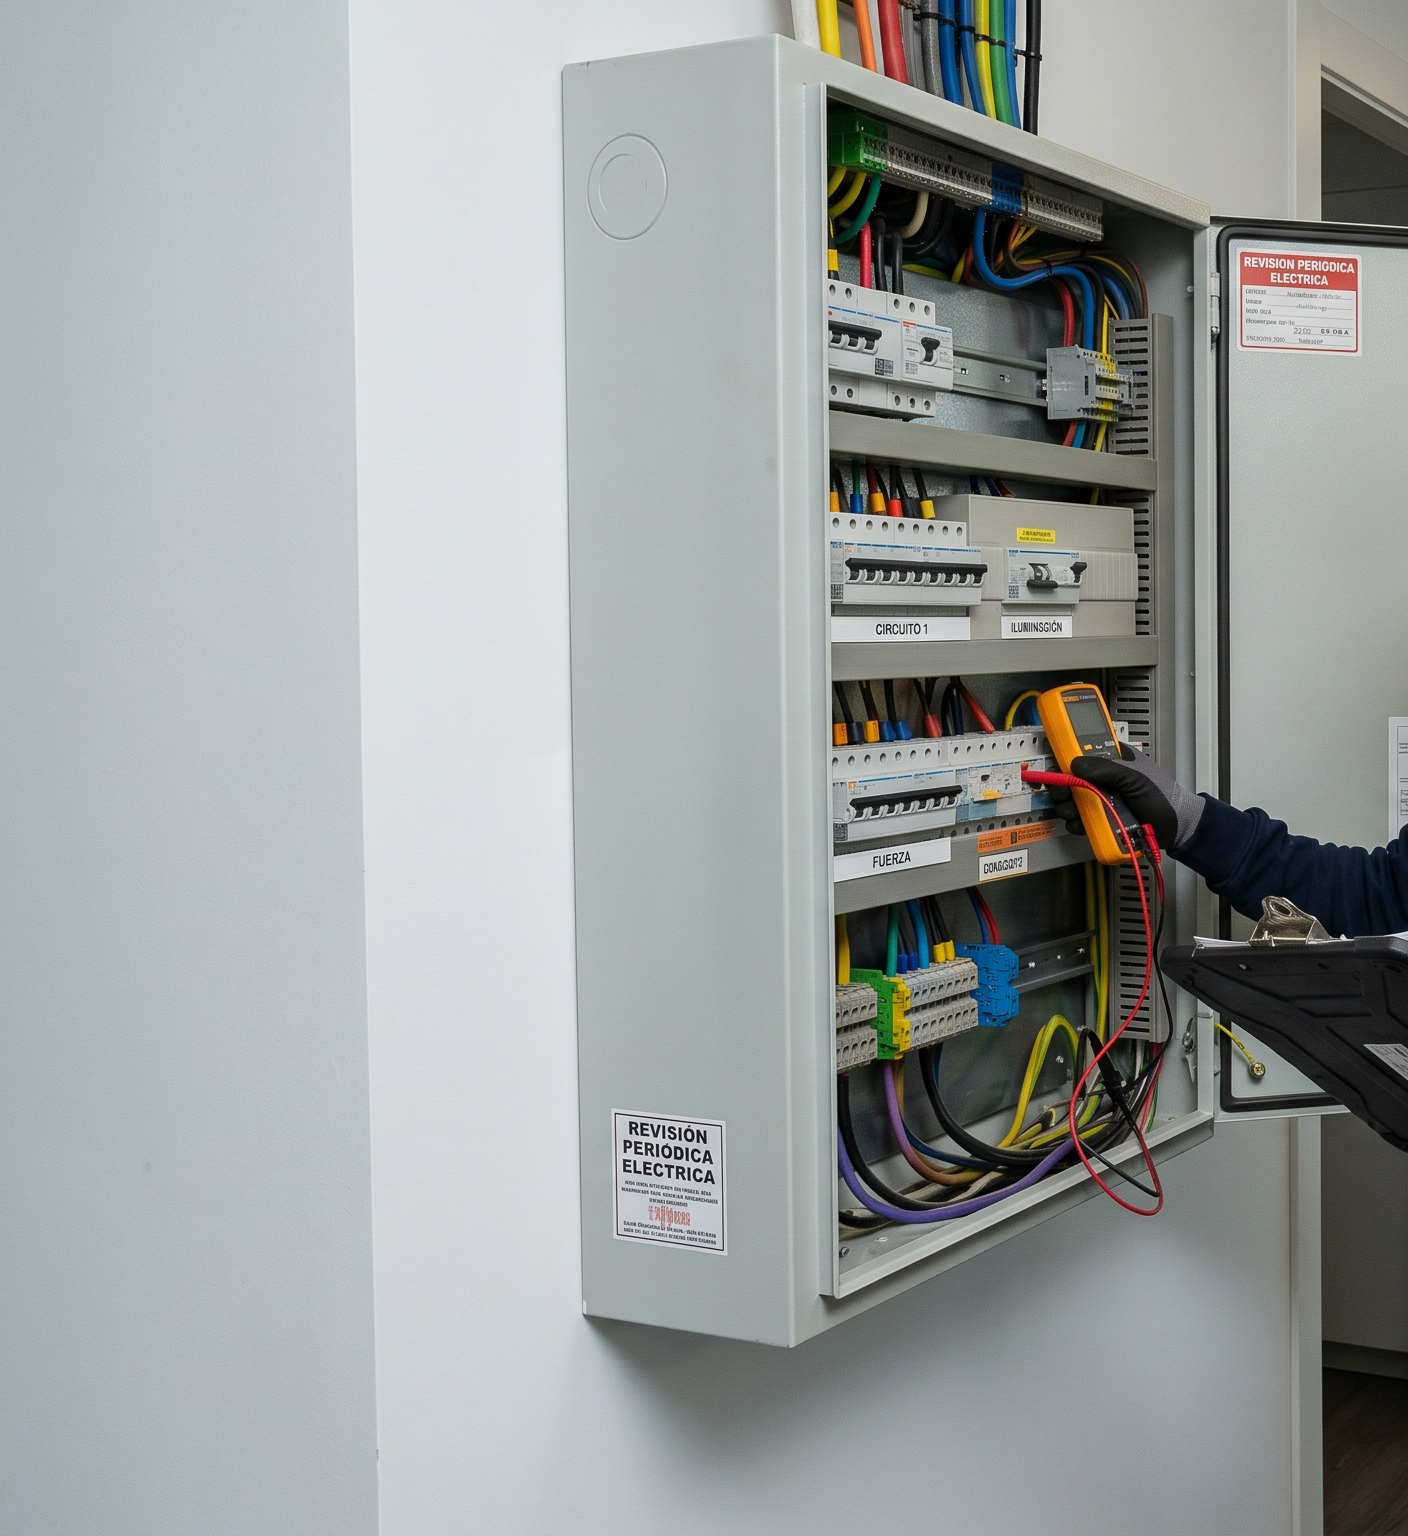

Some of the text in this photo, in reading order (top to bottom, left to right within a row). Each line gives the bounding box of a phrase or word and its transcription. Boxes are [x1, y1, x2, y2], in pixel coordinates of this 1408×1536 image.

[1244, 257, 1295, 270] REVISION
[1270, 272, 1329, 286] ELECTRICA
[875, 623, 928, 636] CIRCUITO 1
[872, 851, 911, 869] FUERZA
[628, 1121, 708, 1145] REVISIÓN
[623, 1139, 714, 1165] PERIÓDICA
[622, 1158, 716, 1185] ELECTRICA
